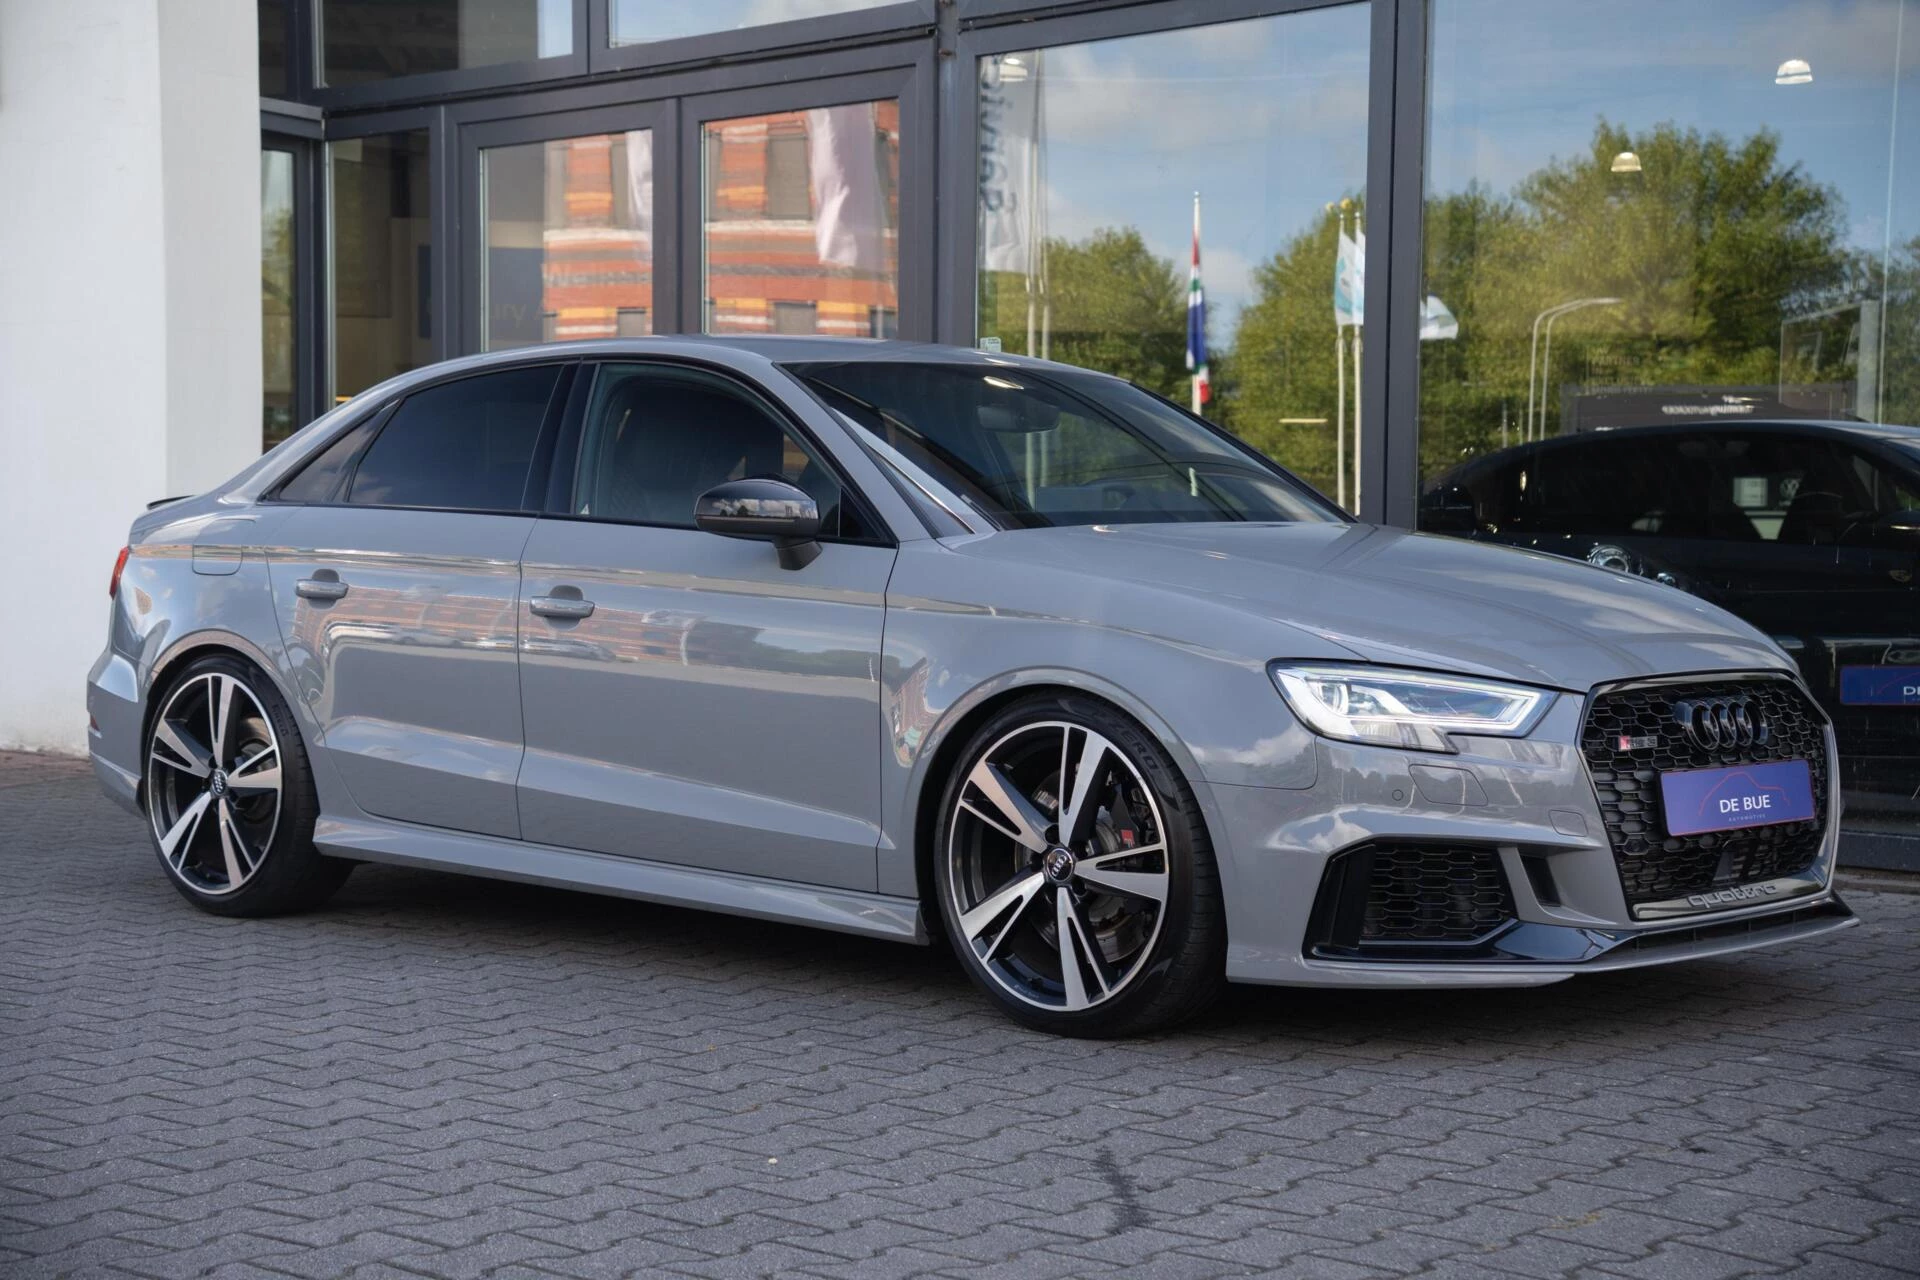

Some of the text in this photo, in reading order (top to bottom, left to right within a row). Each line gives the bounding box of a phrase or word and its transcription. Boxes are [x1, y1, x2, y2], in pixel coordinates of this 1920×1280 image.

[1719, 794, 1772, 814] DE BUE
[1688, 884, 1778, 909] quattro
